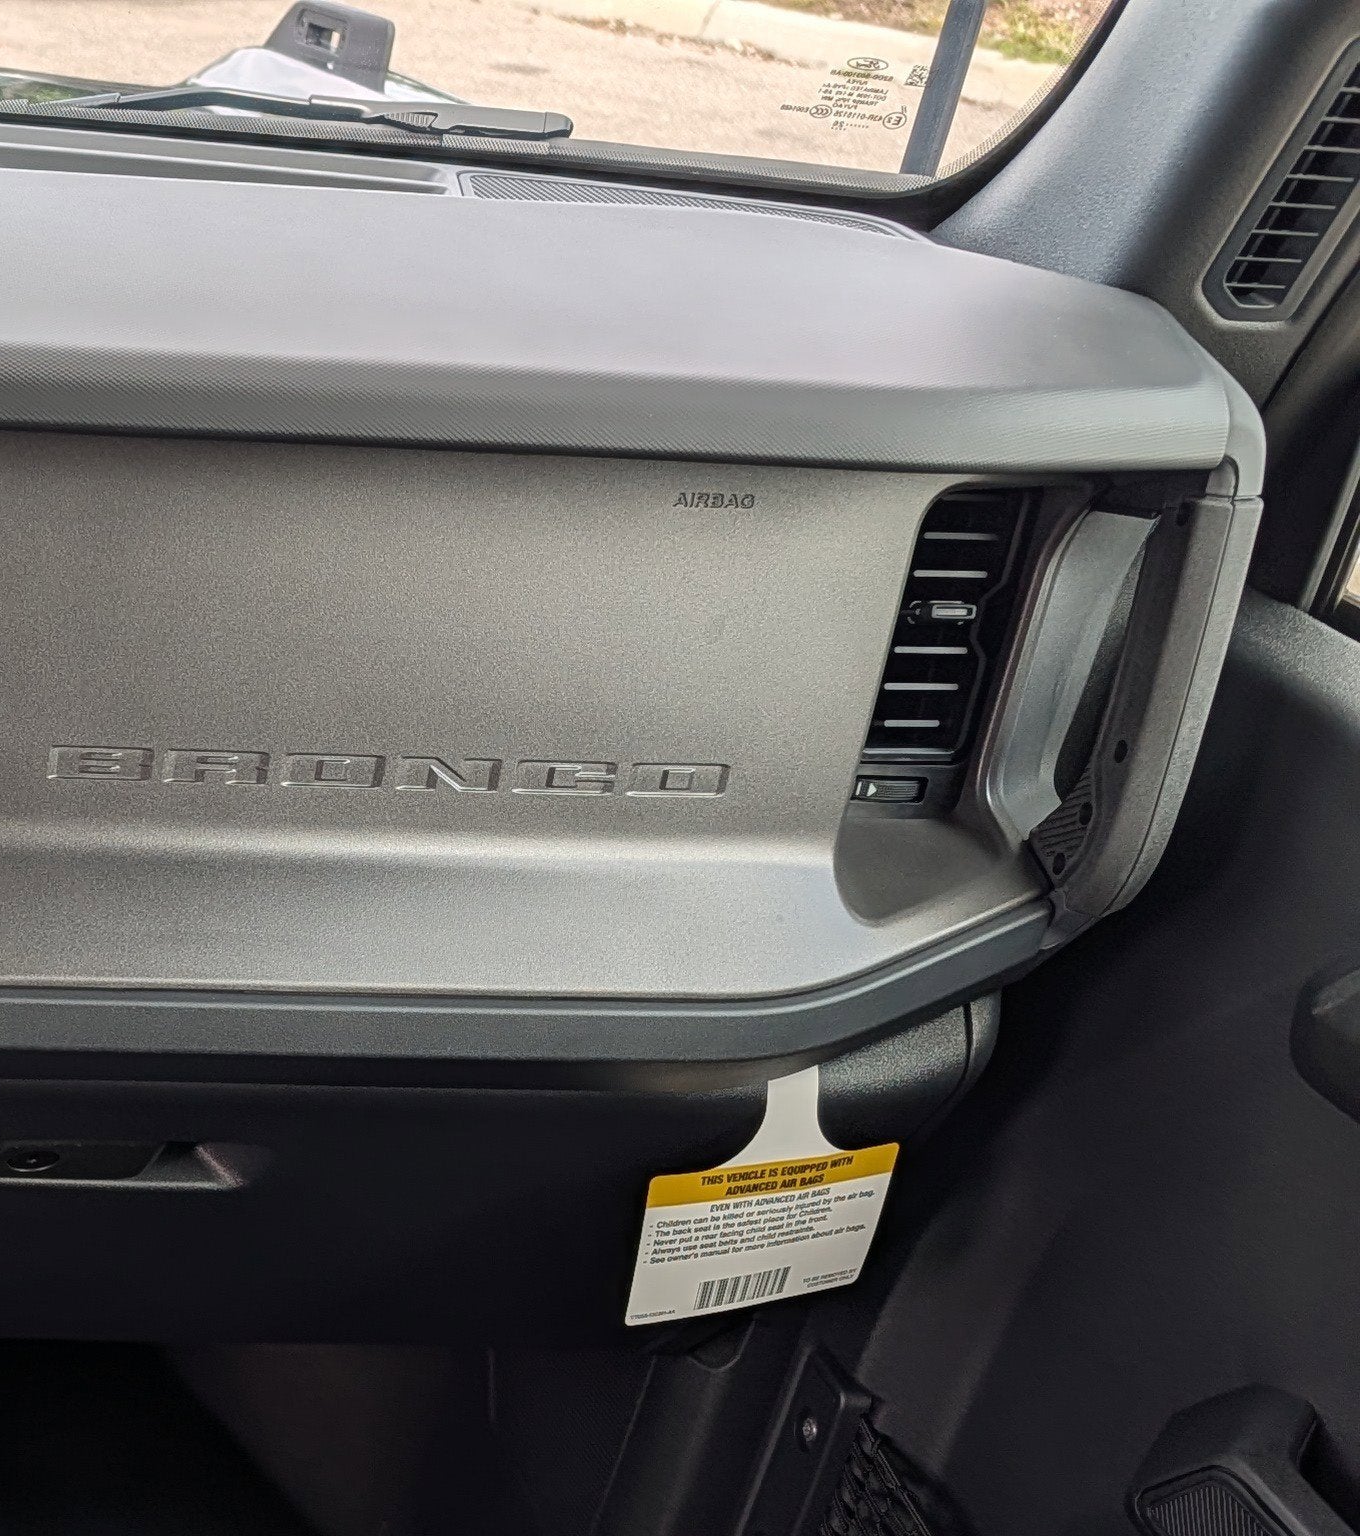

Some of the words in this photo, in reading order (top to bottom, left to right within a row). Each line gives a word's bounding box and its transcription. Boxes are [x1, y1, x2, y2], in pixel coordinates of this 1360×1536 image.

[672, 492, 755, 509] AIRBAG
[47, 744, 731, 798] BRONCO
[701, 1174, 724, 1186] THIS
[726, 1169, 766, 1184] VEHICLE
[781, 1161, 828, 1177] EQUIPPED
[830, 1156, 854, 1168] WITH
[725, 1180, 778, 1196] ADVANCED
[800, 1173, 825, 1186] BAGS
[710, 1202, 731, 1213] EVEN
[732, 1199, 754, 1210] WITH
[754, 1194, 796, 1207] ADVANCED
[810, 1187, 831, 1198] BAGS
[656, 1217, 692, 1229] Children
[722, 1210, 744, 1220] killed
